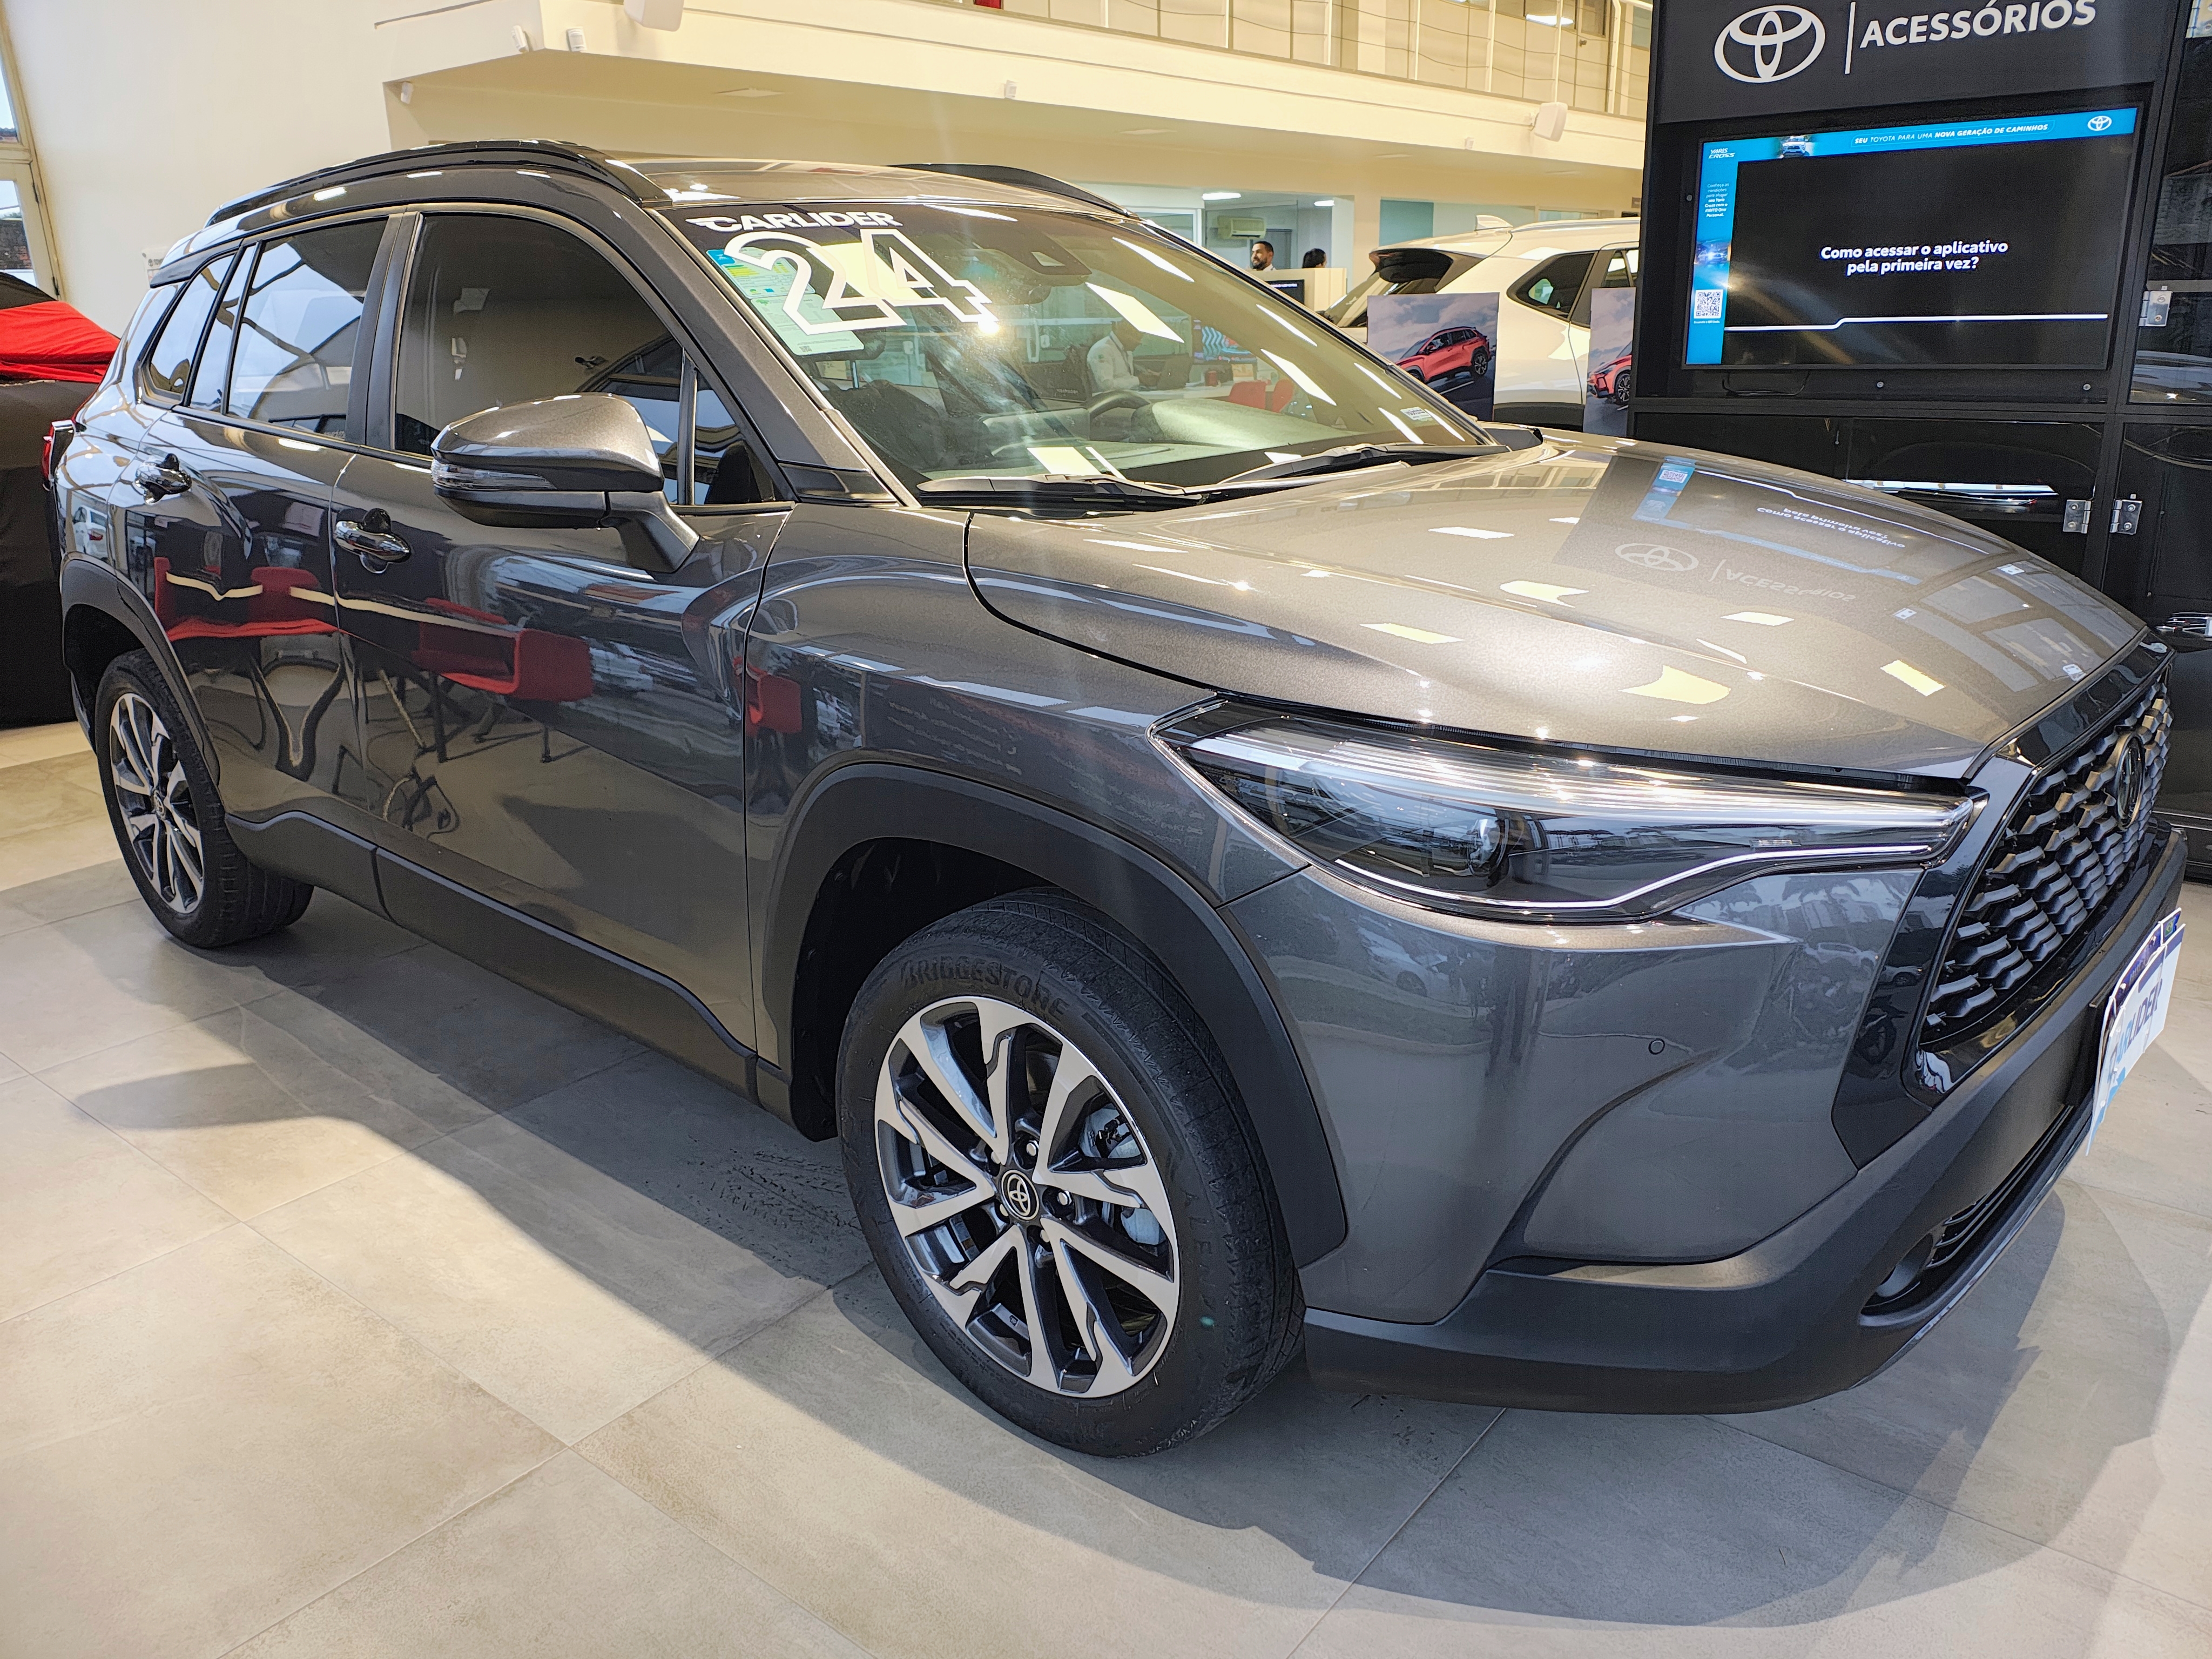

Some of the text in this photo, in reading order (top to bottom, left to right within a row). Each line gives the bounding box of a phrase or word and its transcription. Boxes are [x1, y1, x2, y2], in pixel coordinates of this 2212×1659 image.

[1859, 0, 2096, 49] ACESSÓRIOS
[1870, 135, 1896, 143] TOYOTA
[1957, 127, 1993, 136] GERAÇÃO
[685, 212, 903, 232] CARLIDER
[1820, 240, 2008, 259] Como acessar o aplicativo
[1847, 257, 1979, 276] pela primeira vez?
[724, 228, 1000, 335] 24
